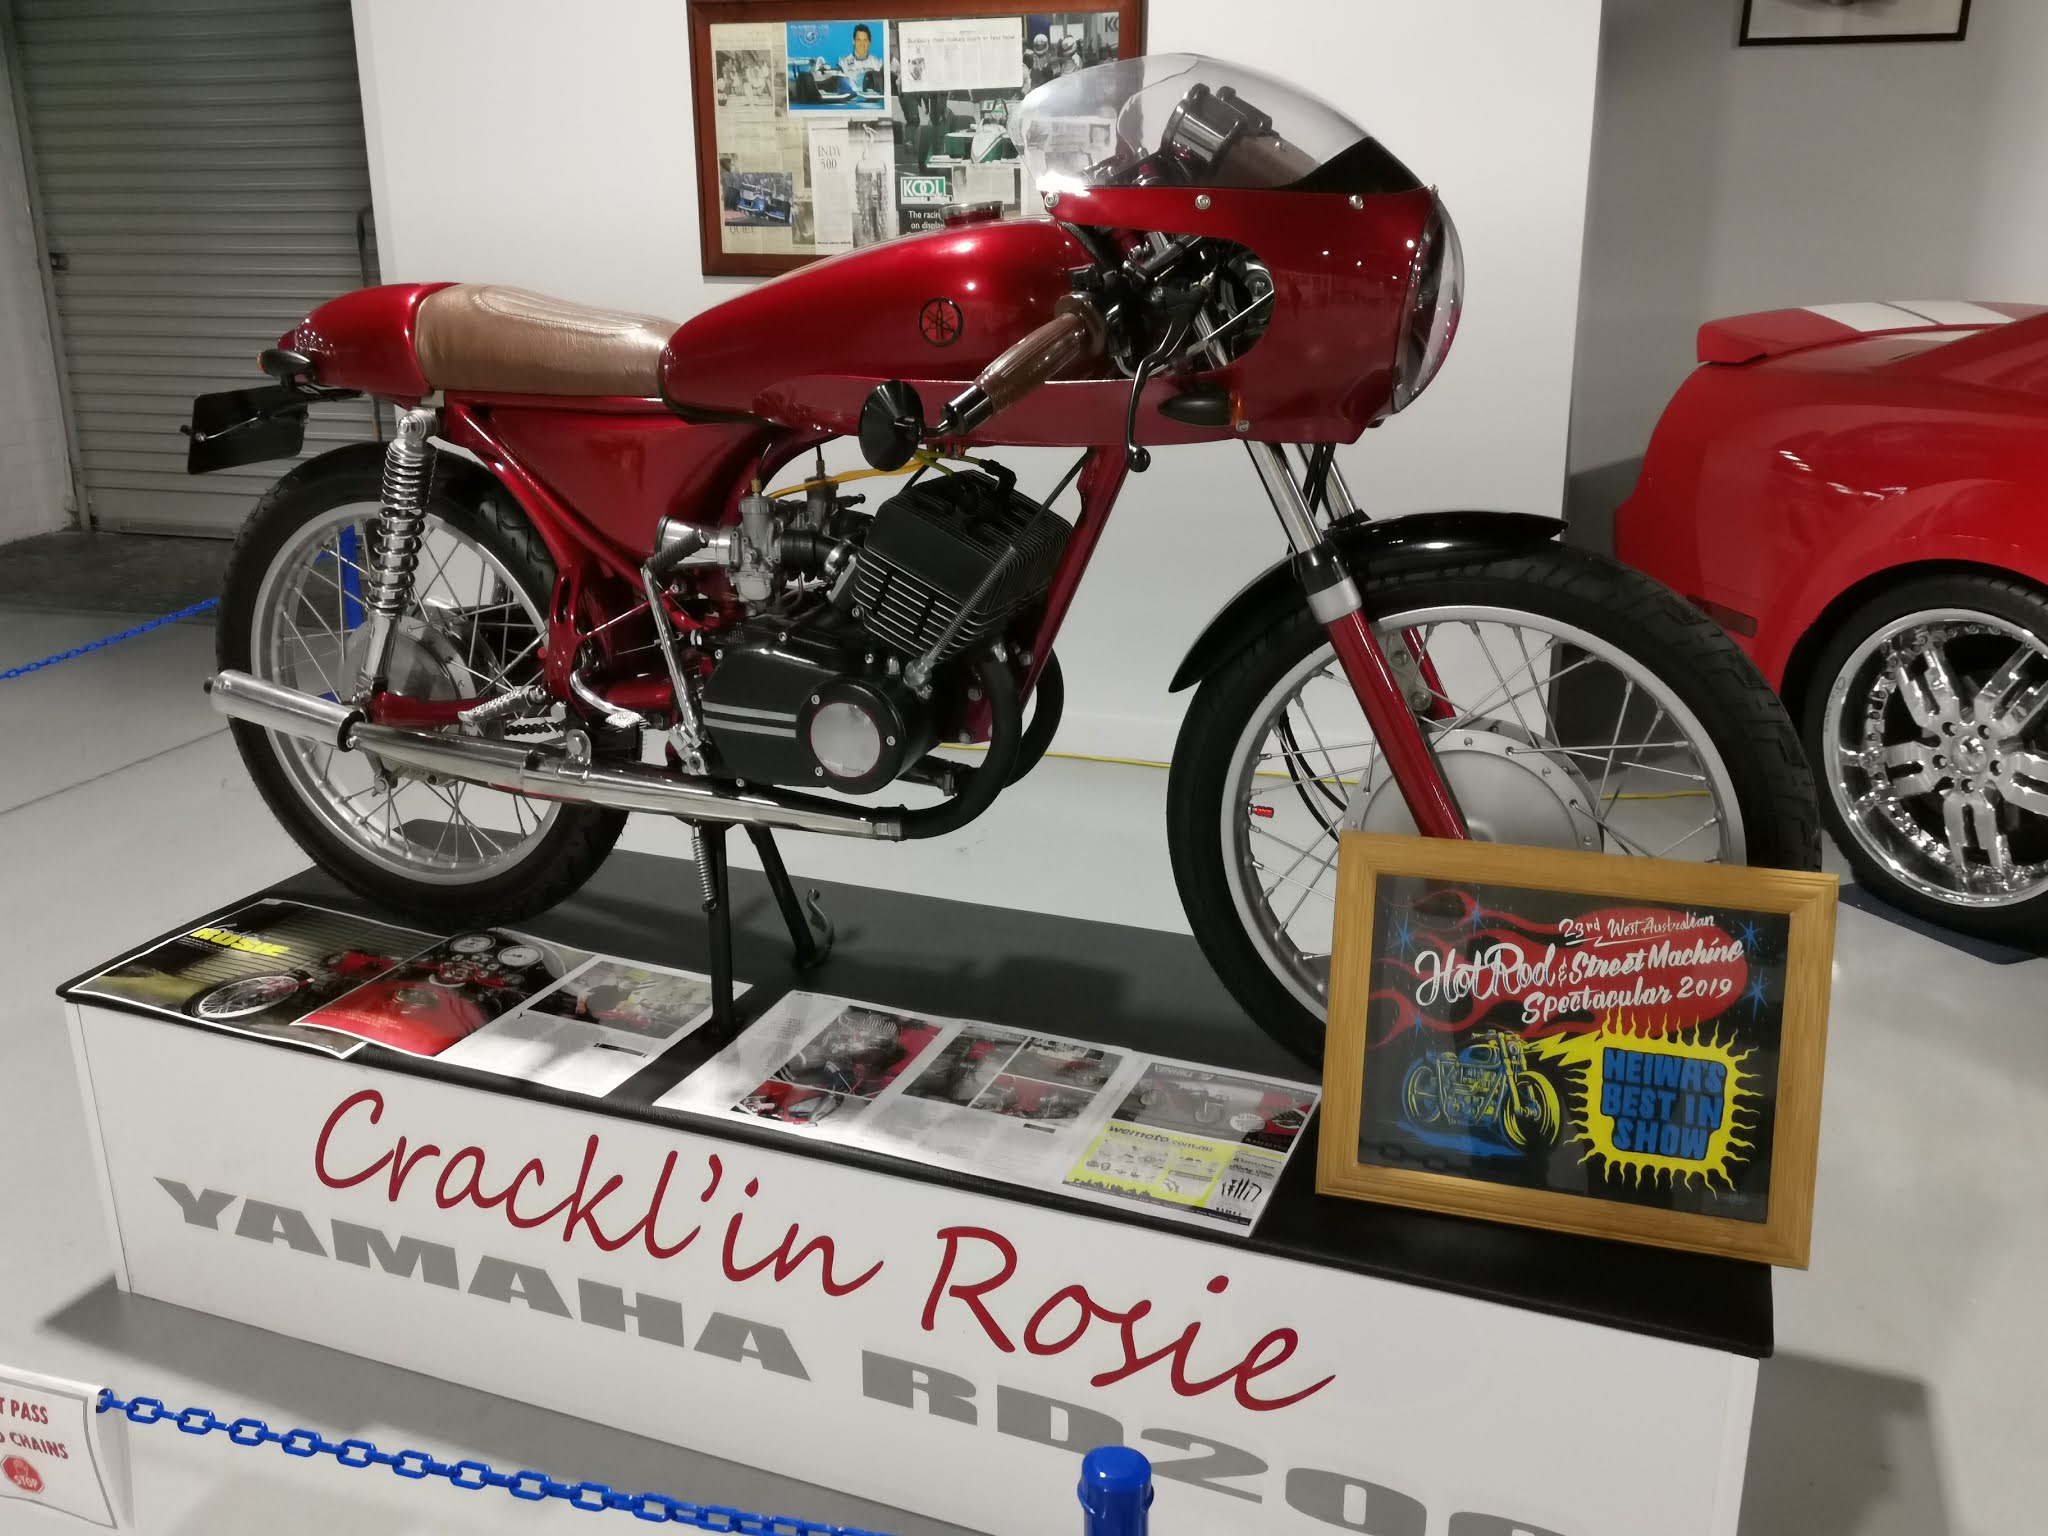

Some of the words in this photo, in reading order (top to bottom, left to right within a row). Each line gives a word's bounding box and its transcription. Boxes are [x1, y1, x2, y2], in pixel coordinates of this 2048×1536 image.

[821, 158, 838, 170] 500
[903, 179, 945, 197] KOOL
[908, 210, 922, 219] The
[923, 210, 943, 219] racin
[1607, 918, 1641, 939] West
[1640, 911, 1715, 935] Australian
[1414, 947, 1488, 1006] Hot
[1484, 943, 1556, 996] Rod
[1557, 956, 1569, 988] &
[1569, 948, 1648, 985] Street
[1648, 937, 1744, 969] Machine
[1521, 975, 1673, 1024] Spectacular
[1677, 975, 1732, 999] 2019
[1603, 1048, 1725, 1094] HEIWA'S
[1601, 1082, 1676, 1121] BEST
[1685, 1093, 1723, 1130] IN
[1613, 1118, 1708, 1161] SHOW
[315, 1089, 884, 1297] Crackl'in
[921, 1226, 1336, 1412] Rosie
[153, 1176, 812, 1382] YAMAHA
[10, 1399, 49, 1425] PASS
[9, 1431, 69, 1460] CHAINS
[14, 1474, 39, 1489] STOP
